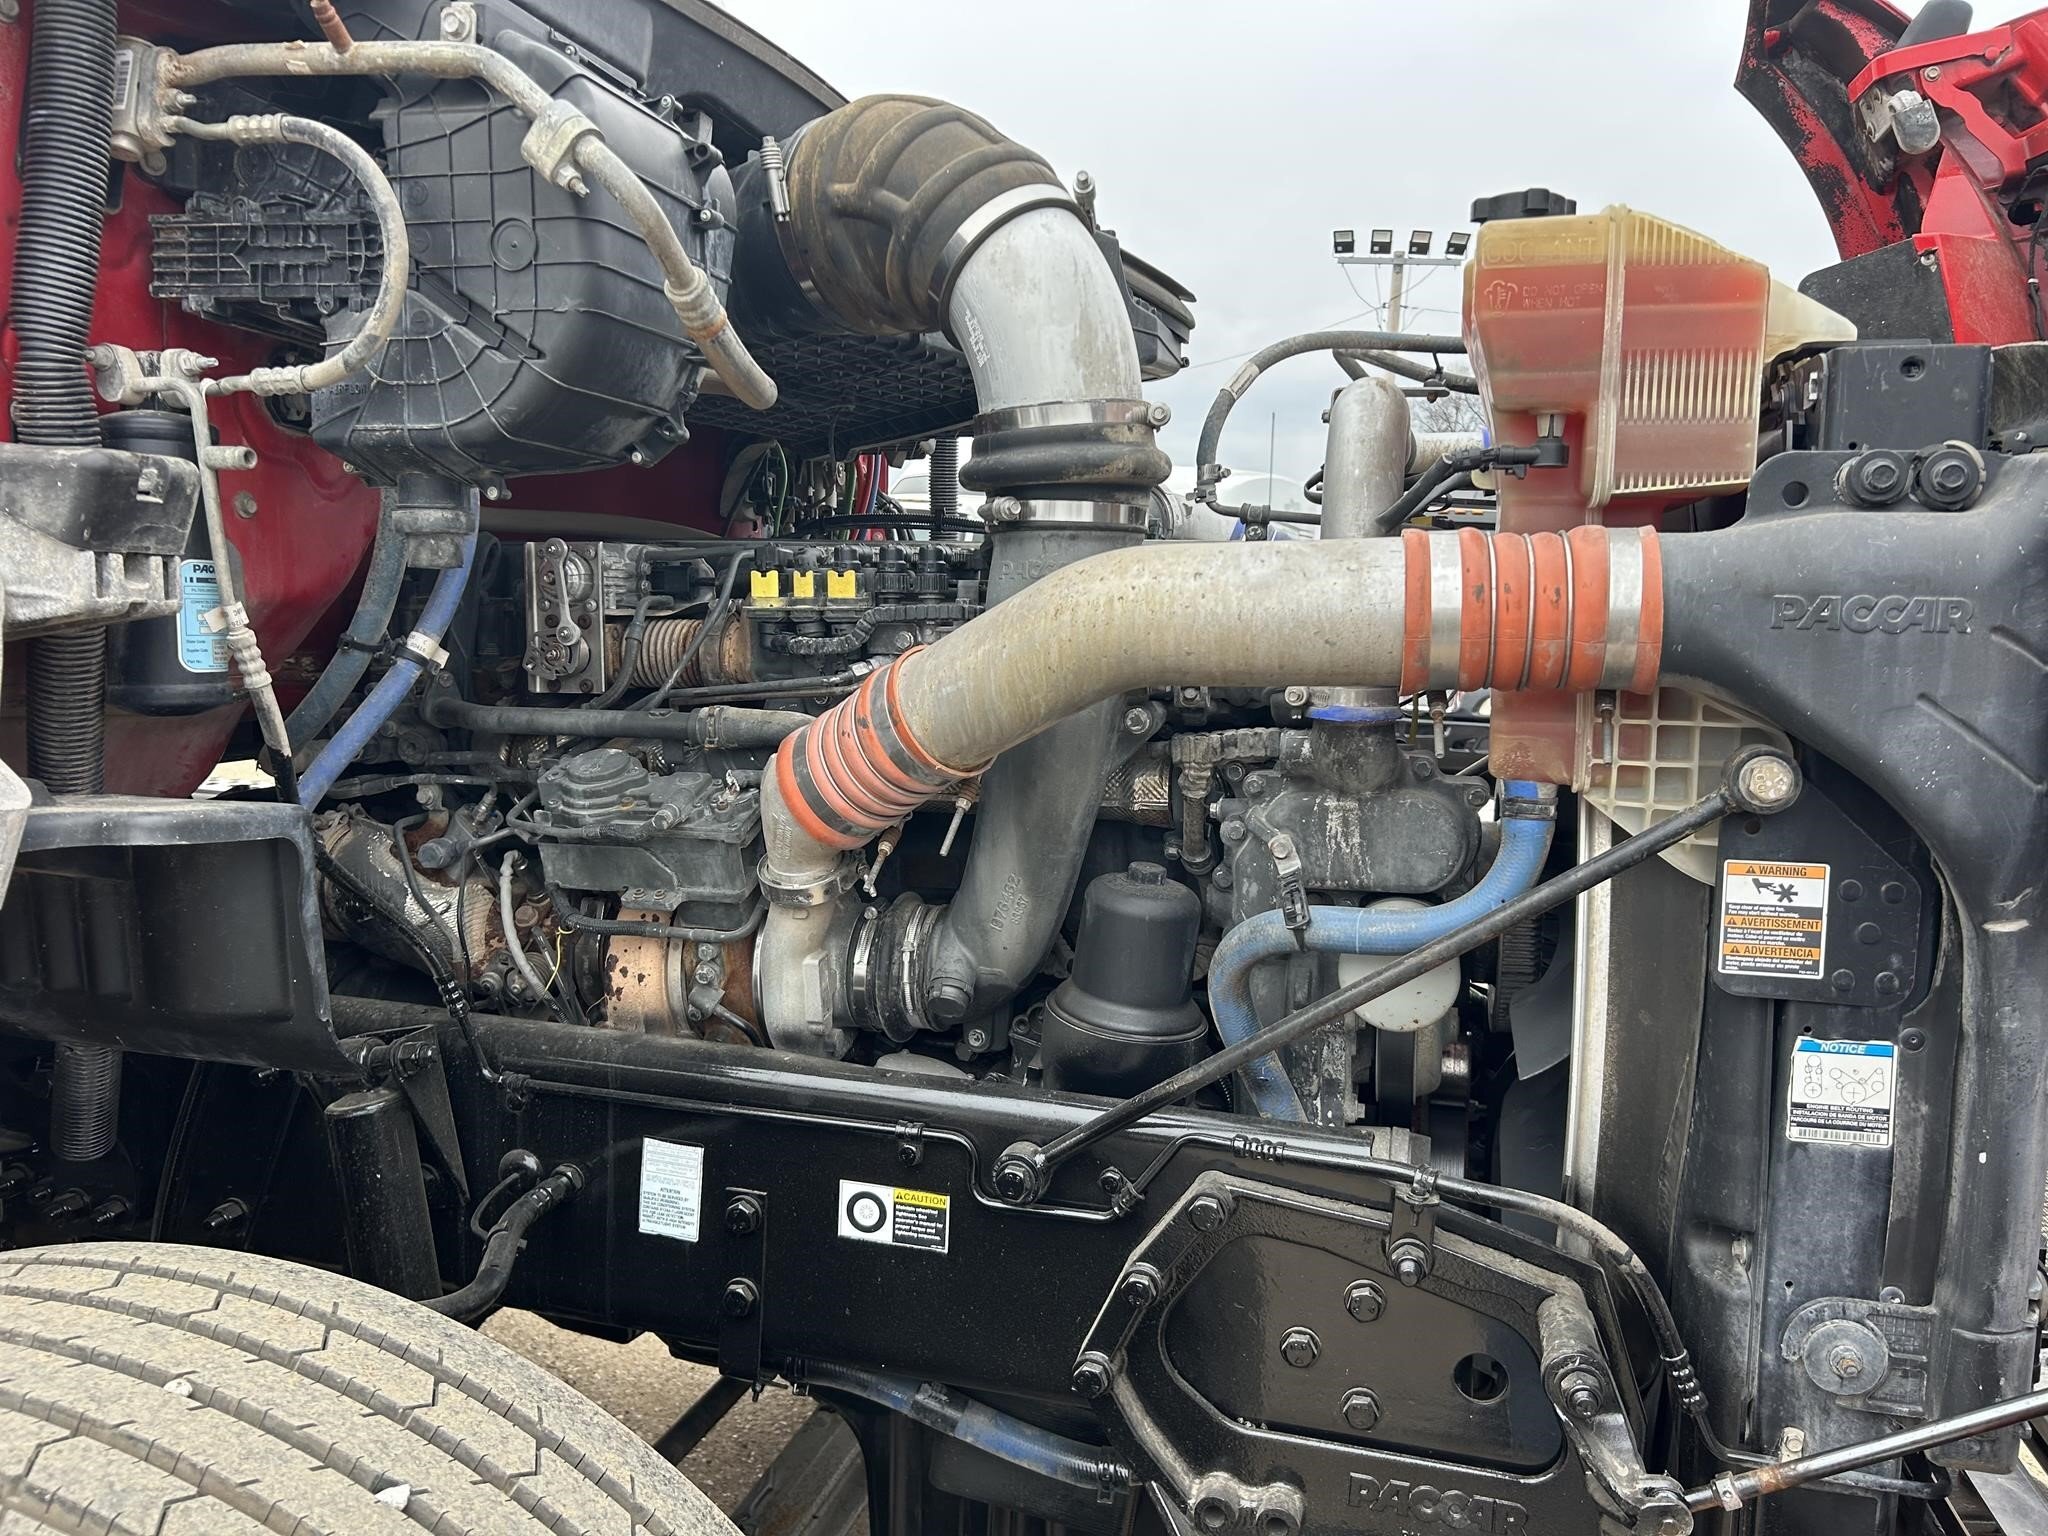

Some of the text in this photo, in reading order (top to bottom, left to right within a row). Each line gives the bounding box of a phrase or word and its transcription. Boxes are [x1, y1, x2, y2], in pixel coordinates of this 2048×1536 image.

[1523, 284, 1603, 296] DO NOT OPEN
[1522, 296, 1580, 308] WHEN HOT
[1771, 595, 1973, 634] PACCAR
[1759, 866, 1807, 876] WARNING
[1740, 918, 1819, 930] AVERTISSEMENT
[1744, 946, 1813, 958] ADVERTENCIA
[1820, 1043, 1866, 1054] NOTICE
[904, 1192, 946, 1206] CAUTION
[1347, 1471, 1529, 1536] PACCAR
